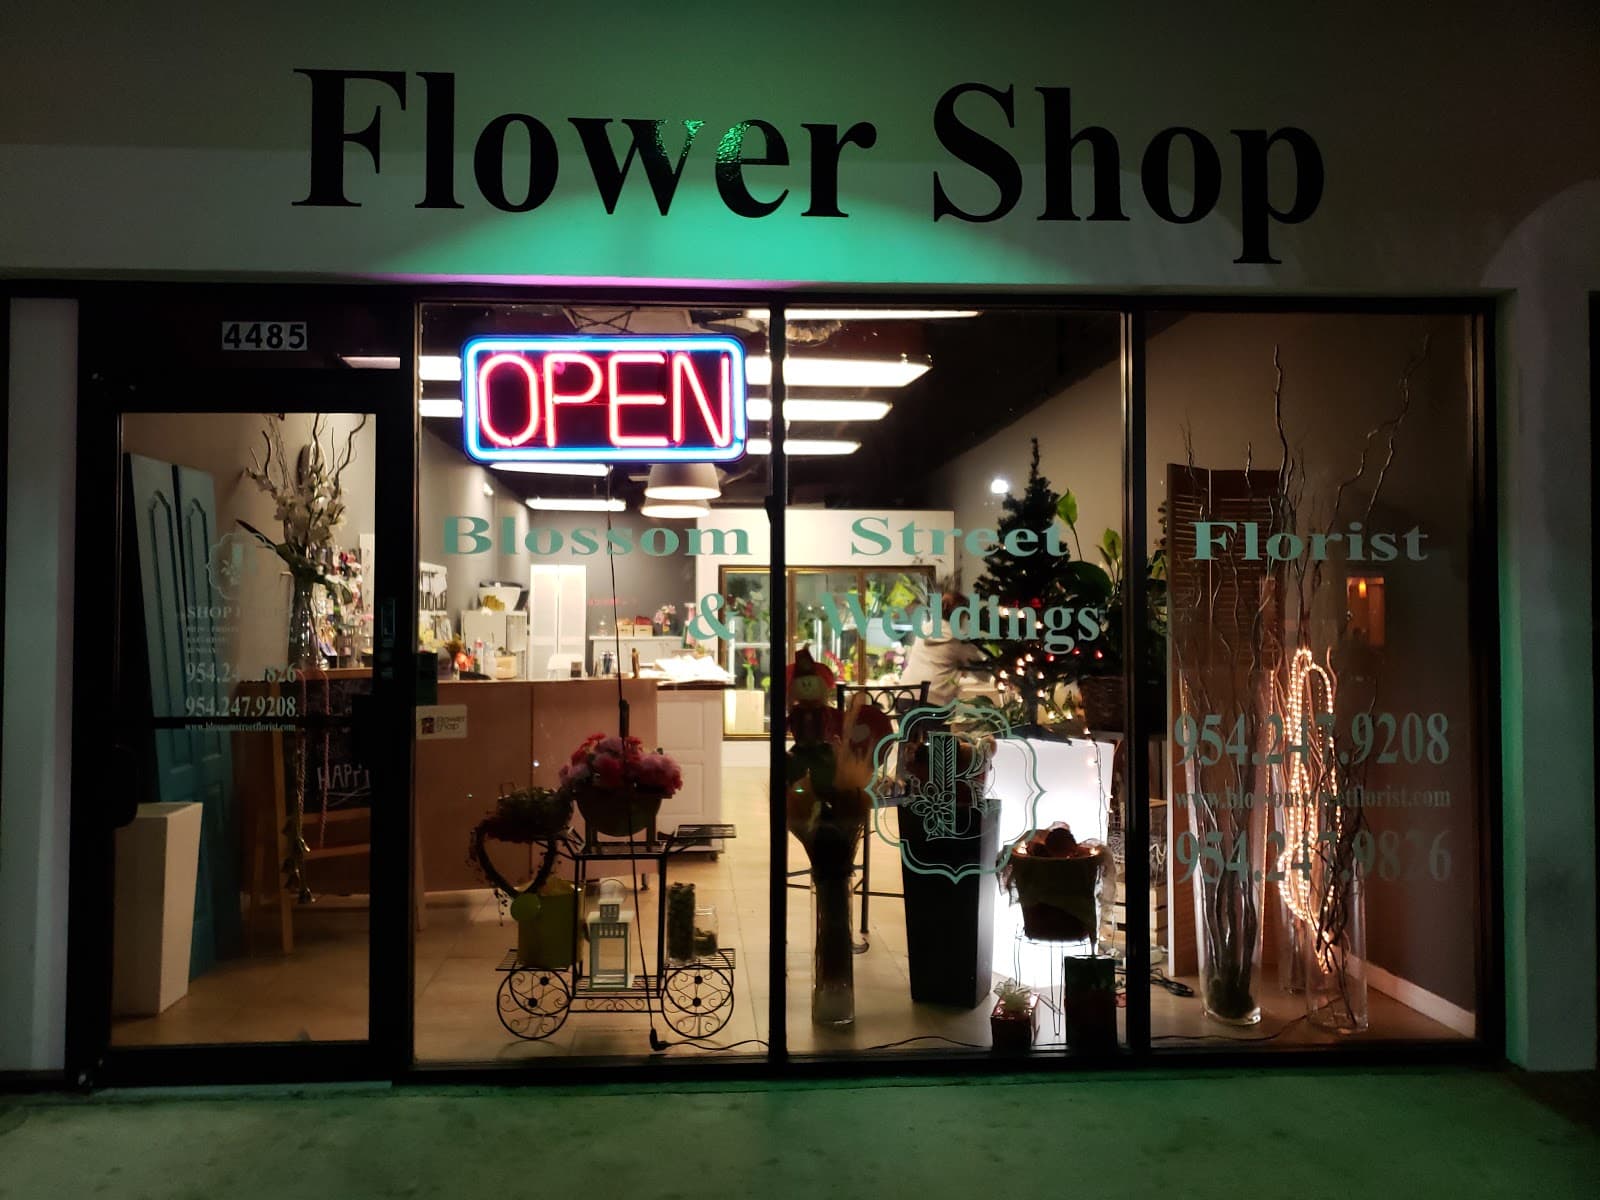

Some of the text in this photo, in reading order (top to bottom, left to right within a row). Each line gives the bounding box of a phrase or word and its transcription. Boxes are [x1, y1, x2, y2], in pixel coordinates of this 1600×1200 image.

[292, 68, 1325, 264] Flower Shop
[223, 323, 306, 349] 4485
[478, 351, 731, 448] OPEN
[442, 516, 1429, 561] Blossom Street Florist
[688, 592, 1101, 655] & Weddings
[185, 662, 297, 683] 954.24826
[185, 697, 297, 717] 954.247.9208
[1174, 712, 1451, 766] 954.247.9208
